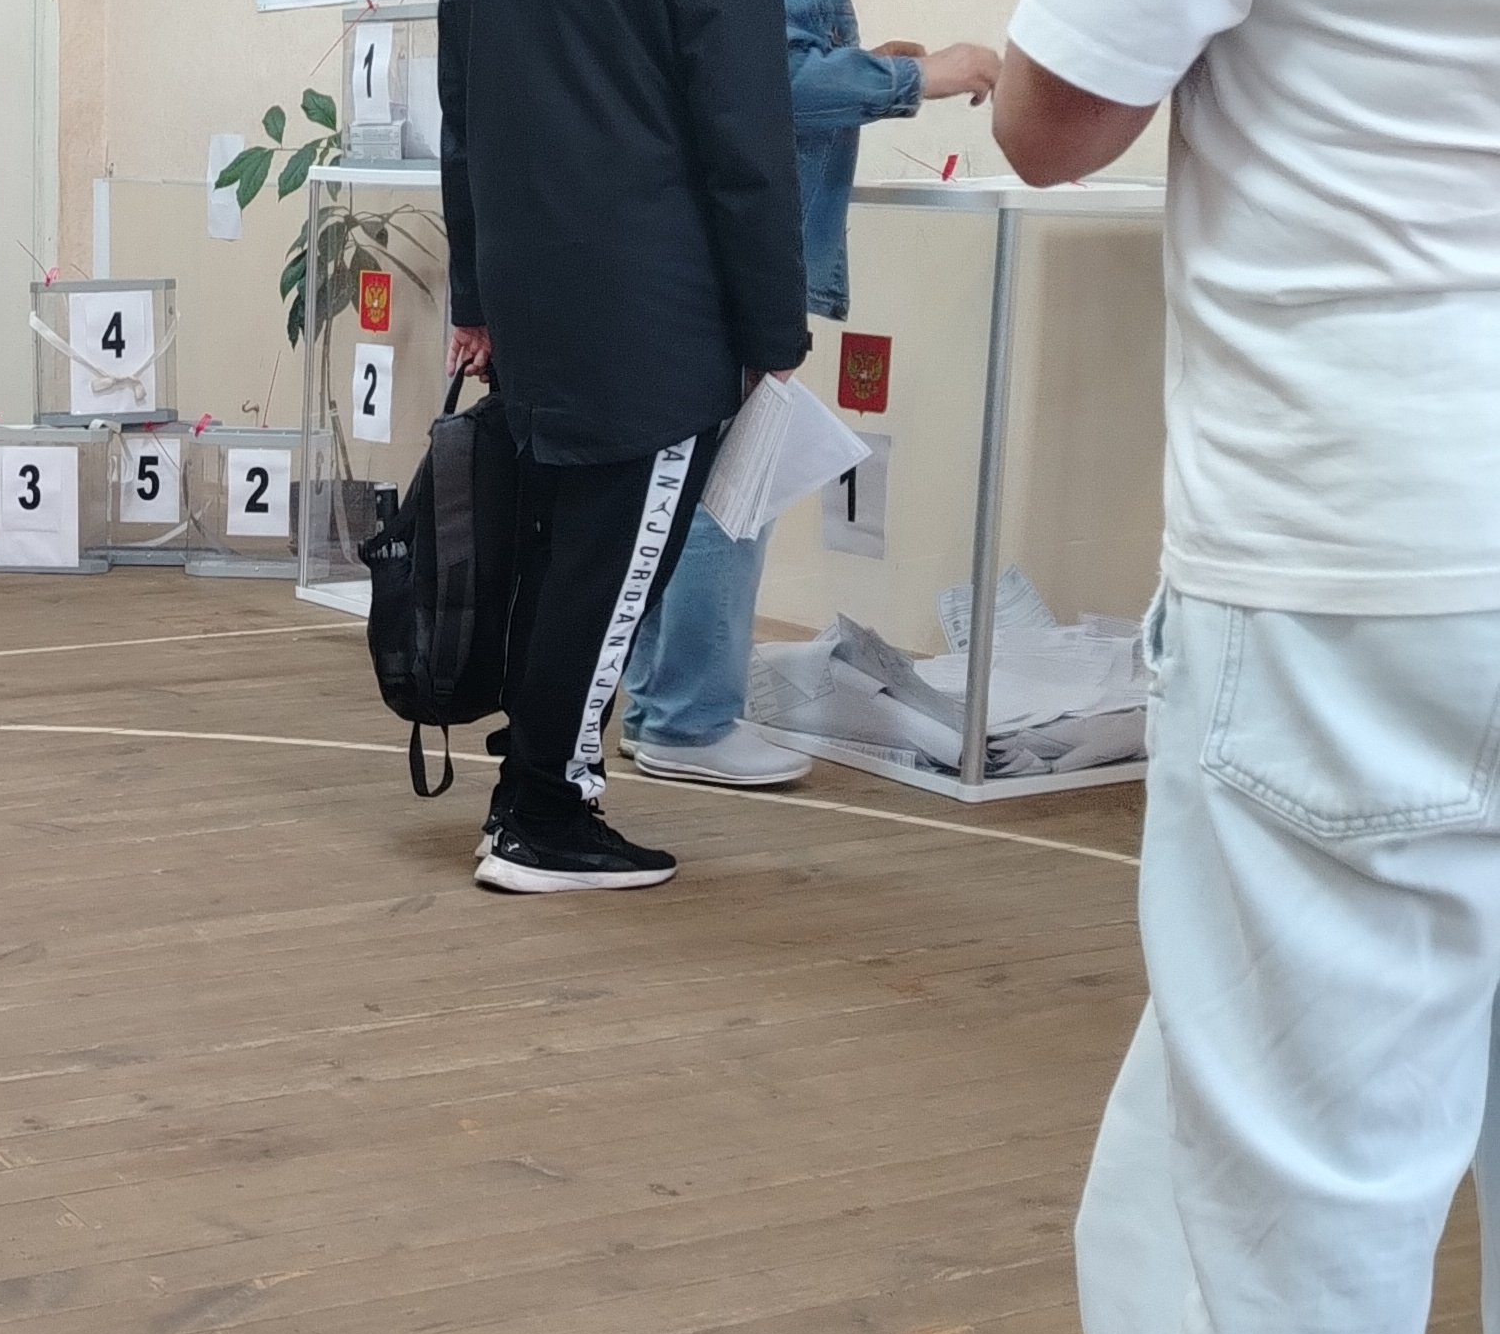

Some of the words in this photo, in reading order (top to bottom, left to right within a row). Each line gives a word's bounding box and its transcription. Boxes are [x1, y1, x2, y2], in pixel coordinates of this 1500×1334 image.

[362, 42, 376, 99] 1
[101, 311, 126, 358] 4
[362, 362, 378, 417] 2
[17, 464, 41, 510] 3
[136, 455, 160, 501] 5
[244, 466, 270, 514] 2
[839, 465, 857, 523] 1
[607, 521, 667, 648] JORDAN
[569, 678, 614, 781] JORDN
